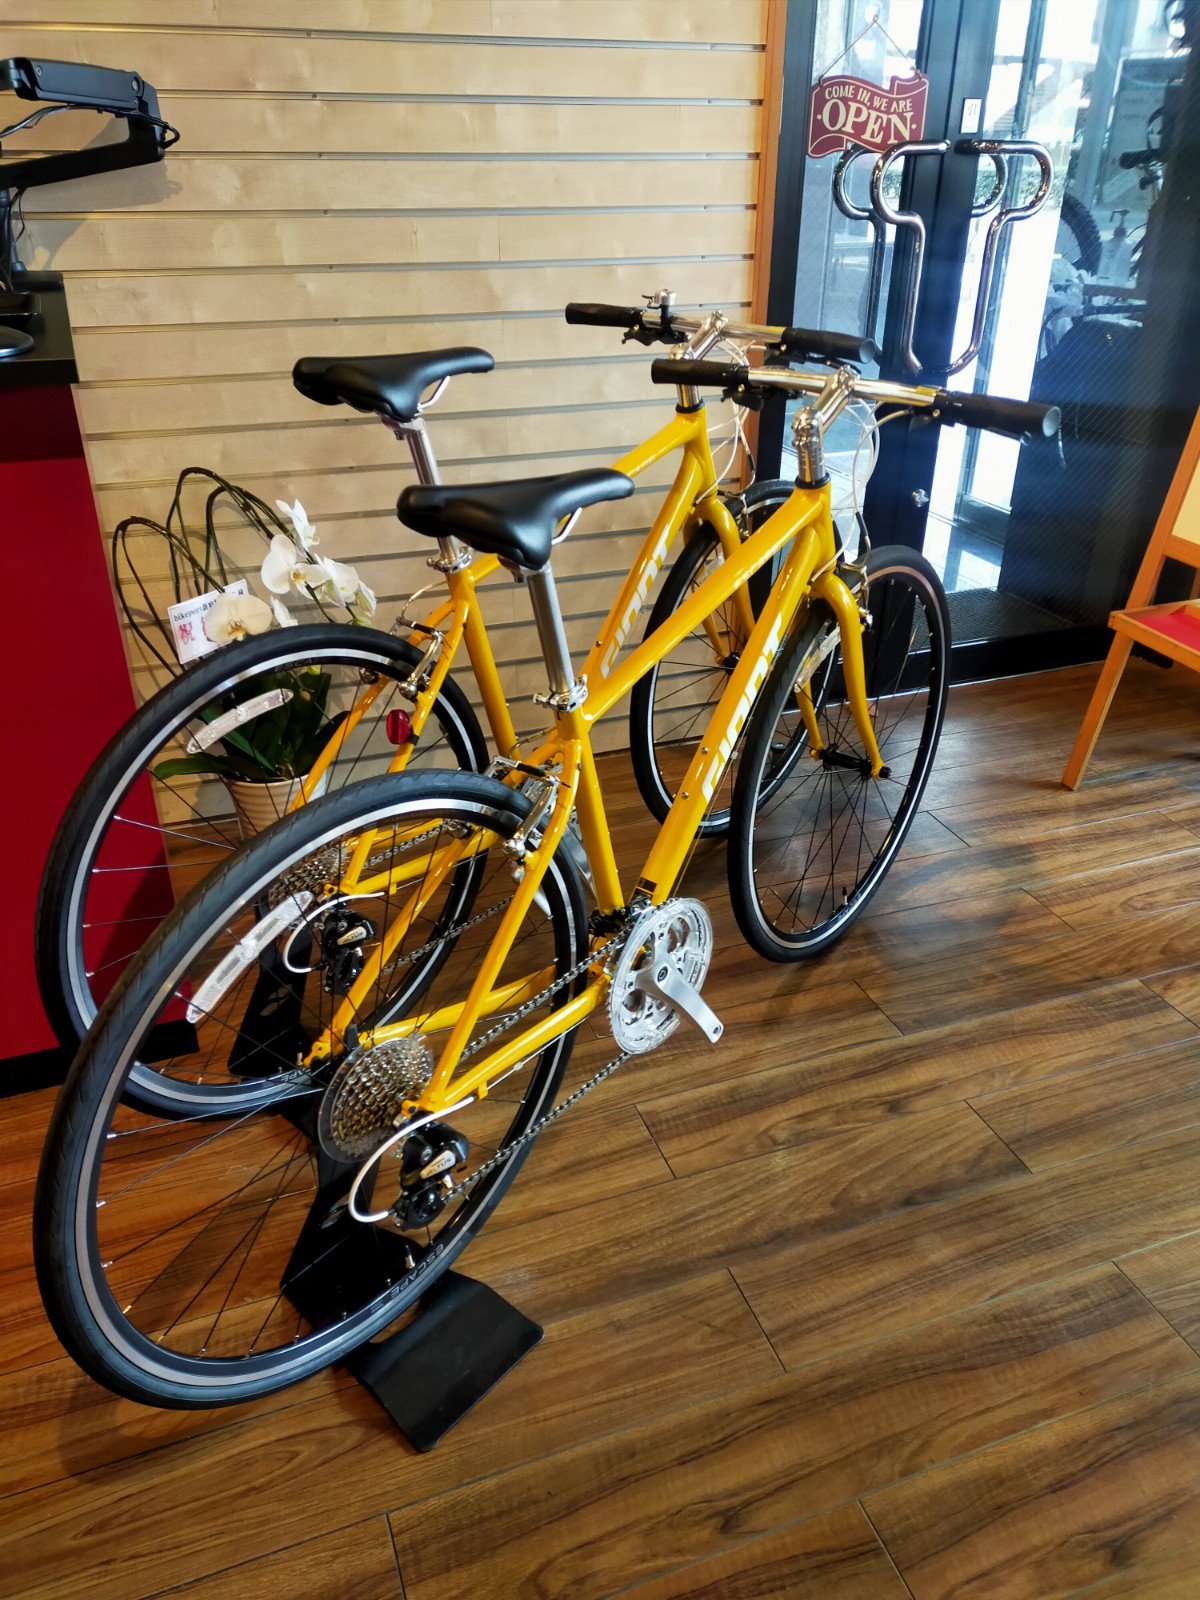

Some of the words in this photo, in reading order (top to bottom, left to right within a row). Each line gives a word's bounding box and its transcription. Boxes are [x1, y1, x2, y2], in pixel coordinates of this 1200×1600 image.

[825, 85, 855, 100] COME
[857, 88, 871, 107] IN,
[873, 96, 888, 111] WE
[891, 99, 913, 112] ARE
[823, 99, 914, 144] OPEN
[390, 1243, 444, 1299] ESCAPE
